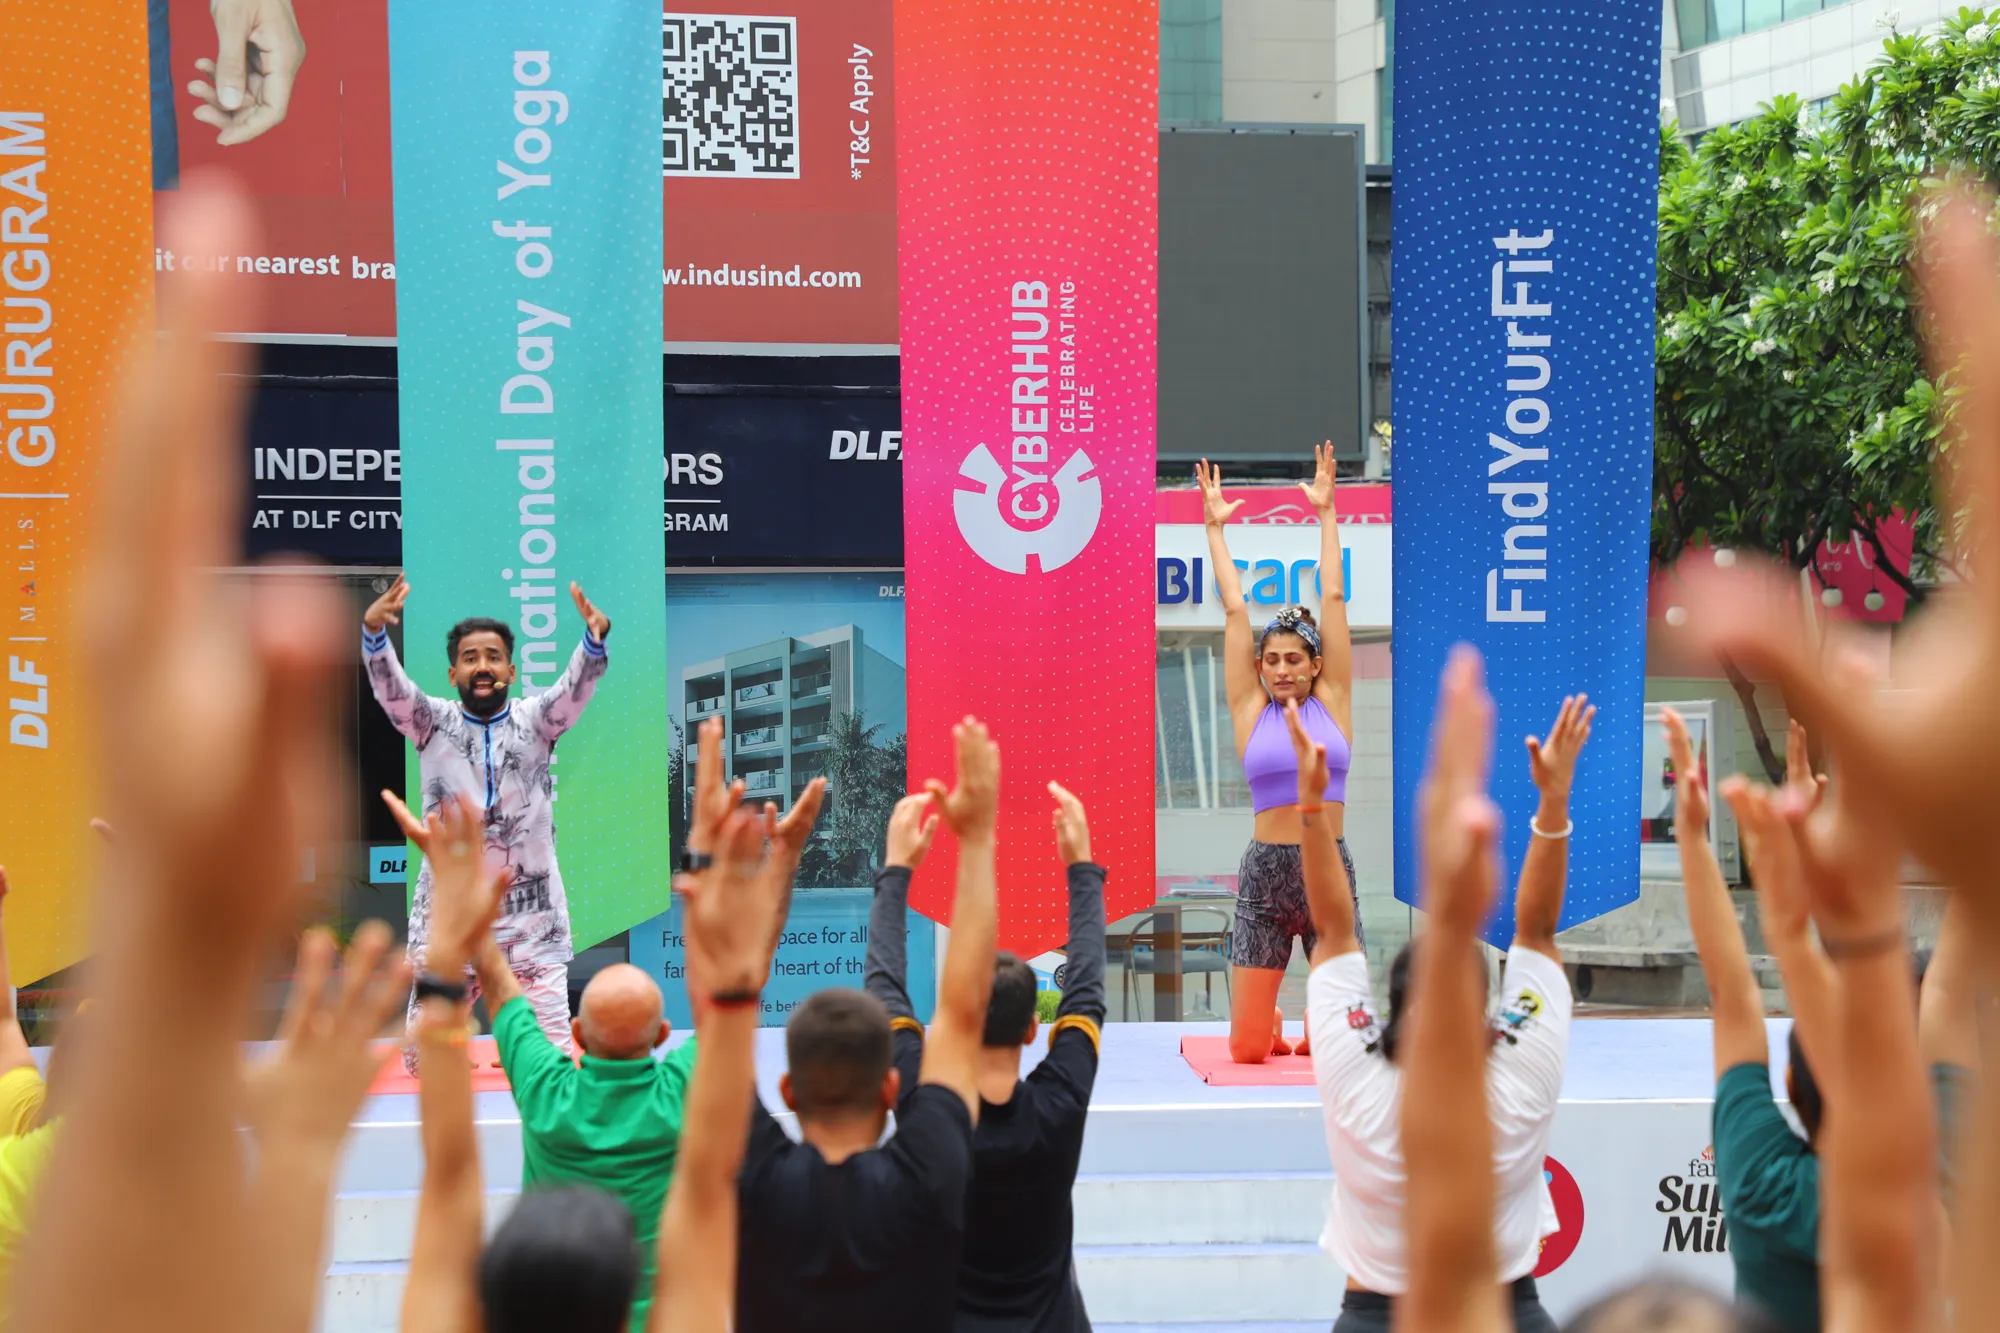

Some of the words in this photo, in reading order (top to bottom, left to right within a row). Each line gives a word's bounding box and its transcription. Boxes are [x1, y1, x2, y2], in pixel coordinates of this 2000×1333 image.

[848, 43, 874, 114] Apply
[497, 50, 569, 201] Yoga
[155, 248, 175, 272] it
[237, 254, 340, 275] nearest
[352, 256, 396, 279] bra
[492, 220, 553, 279] of
[0, 111, 56, 467] GURUGRAM
[500, 299, 571, 414] Day
[1060, 281, 1075, 433] CELEBRATING
[1012, 280, 1049, 520] CYBERHUB
[1079, 385, 1094, 433] LIFE
[1486, 229, 1553, 622] FindYourFit
[254, 447, 401, 482] INDEPE
[664, 453, 724, 486] RS
[252, 510, 284, 529] AT
[293, 510, 341, 529] DLF
[8, 655, 48, 749] DLF
[775, 958, 820, 976] heart
[824, 957, 842, 975] of
[845, 956, 866, 974] th
[822, 926, 847, 944] for
[850, 926, 868, 943] all
